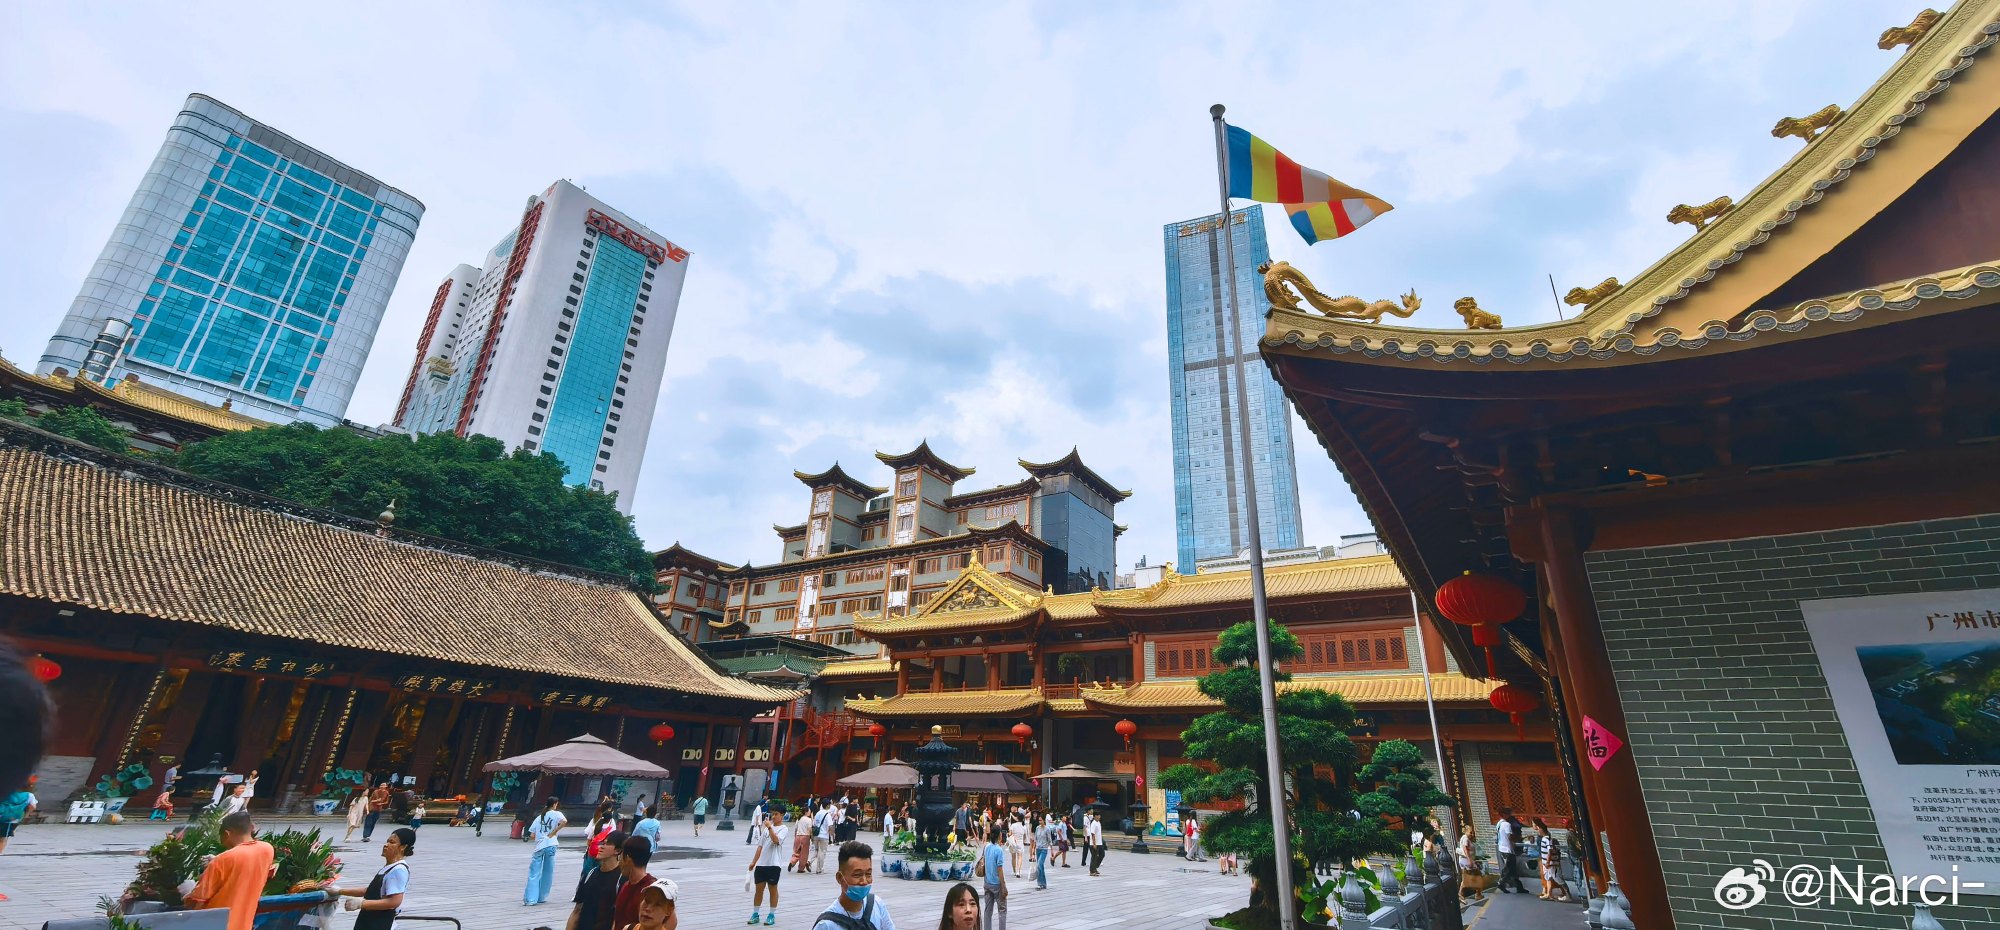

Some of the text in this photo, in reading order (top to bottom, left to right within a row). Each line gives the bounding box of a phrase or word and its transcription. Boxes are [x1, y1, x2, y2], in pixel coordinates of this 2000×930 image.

[1925, 609, 2000, 632] 广州市
[1583, 727, 1608, 759] 福
